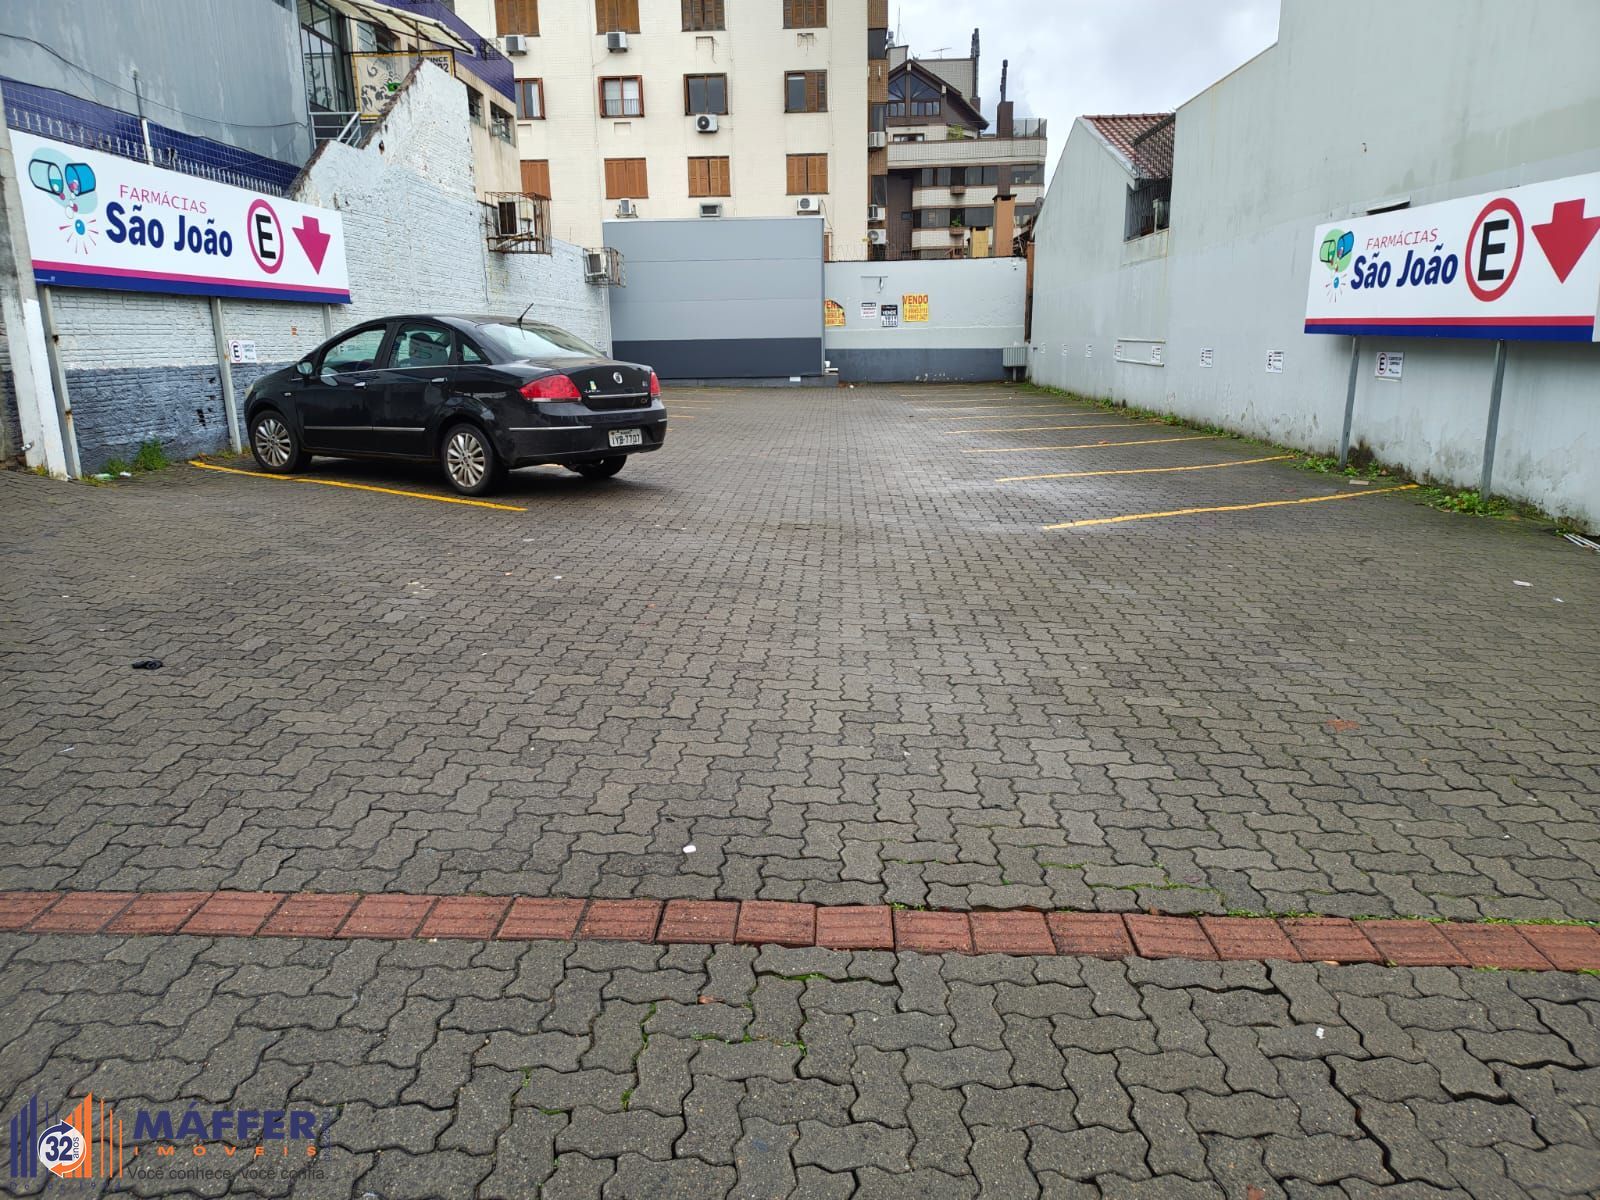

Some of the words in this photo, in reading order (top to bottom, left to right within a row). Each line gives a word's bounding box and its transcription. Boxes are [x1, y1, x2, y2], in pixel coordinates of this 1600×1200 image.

[119, 184, 208, 214] FARMÁCIAS
[105, 201, 165, 249] São
[173, 214, 233, 258] João
[255, 213, 277, 260] E
[1365, 228, 1439, 250] FARMÁCIAS
[1477, 218, 1510, 282] E
[1350, 251, 1391, 290] São
[1396, 243, 1459, 288] João
[902, 295, 928, 304] VENDO
